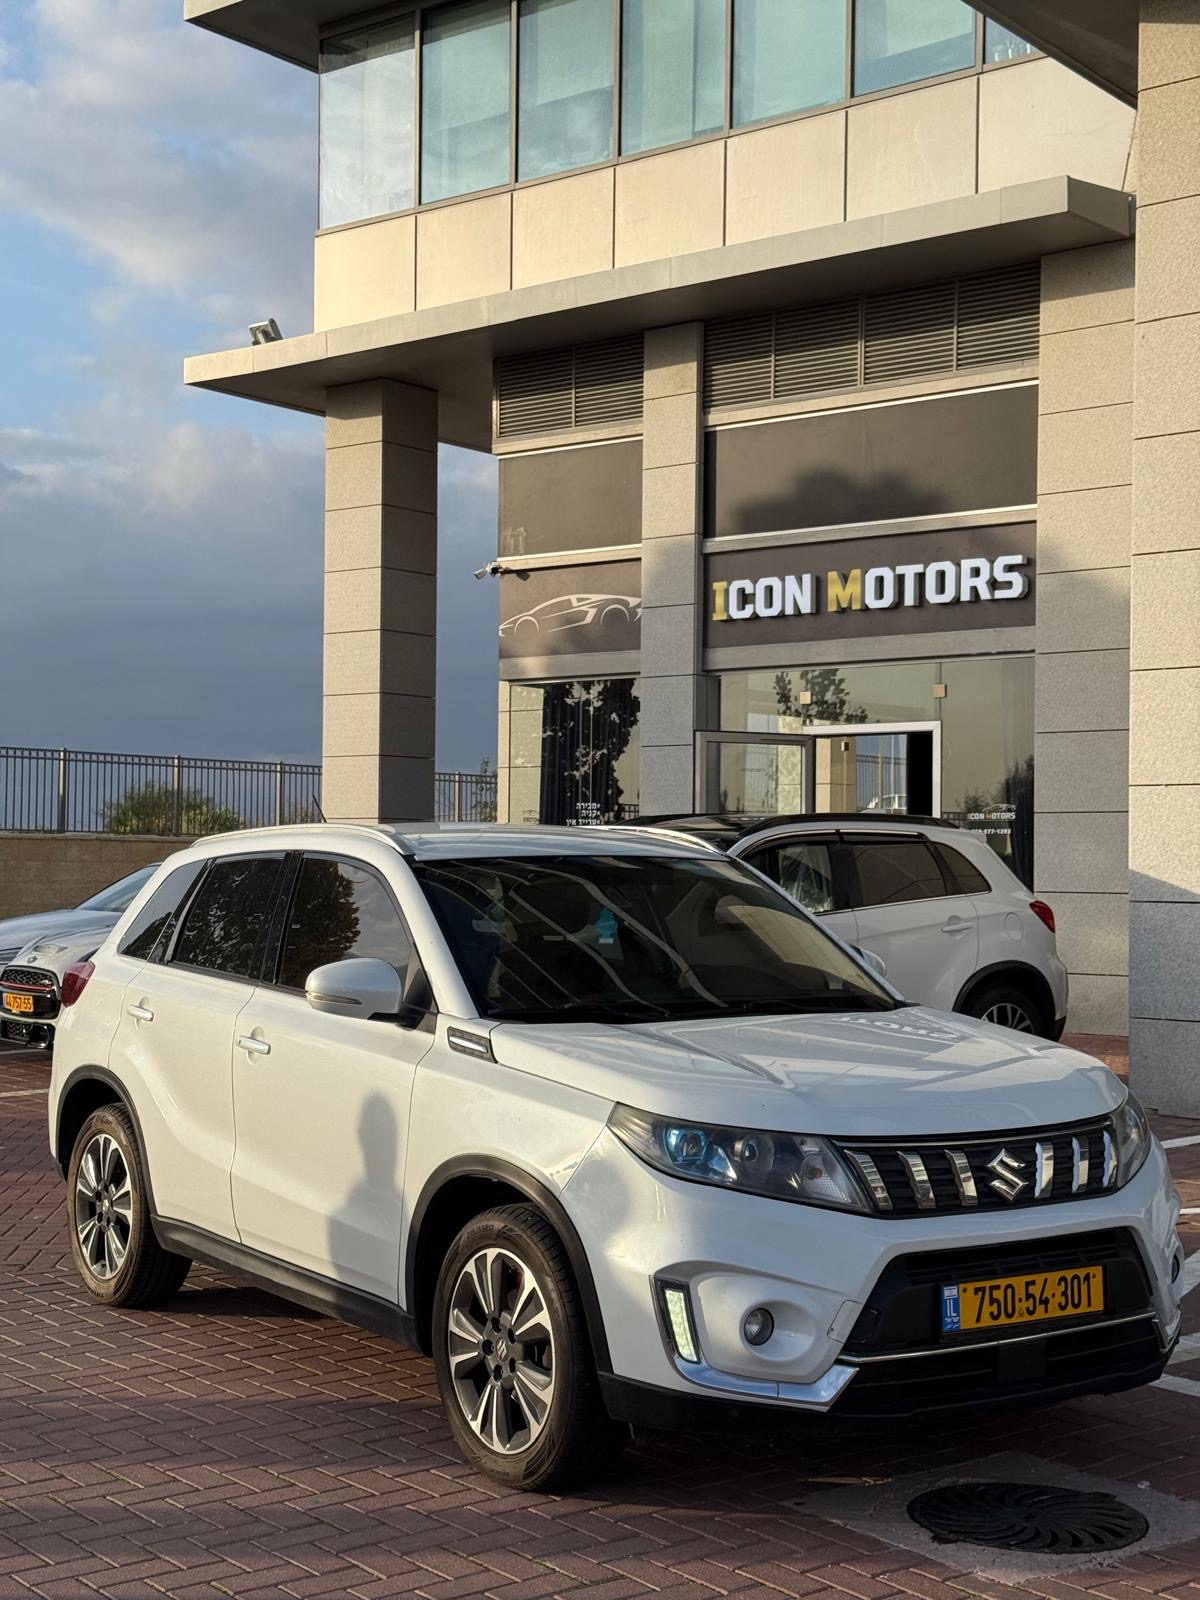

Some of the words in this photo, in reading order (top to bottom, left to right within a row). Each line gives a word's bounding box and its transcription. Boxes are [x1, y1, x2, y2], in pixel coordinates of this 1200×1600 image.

[712, 573, 815, 621] ICON
[827, 554, 1027, 612] MOTORS
[581, 810, 597, 818] קניה
[946, 1299, 958, 1317] IL
